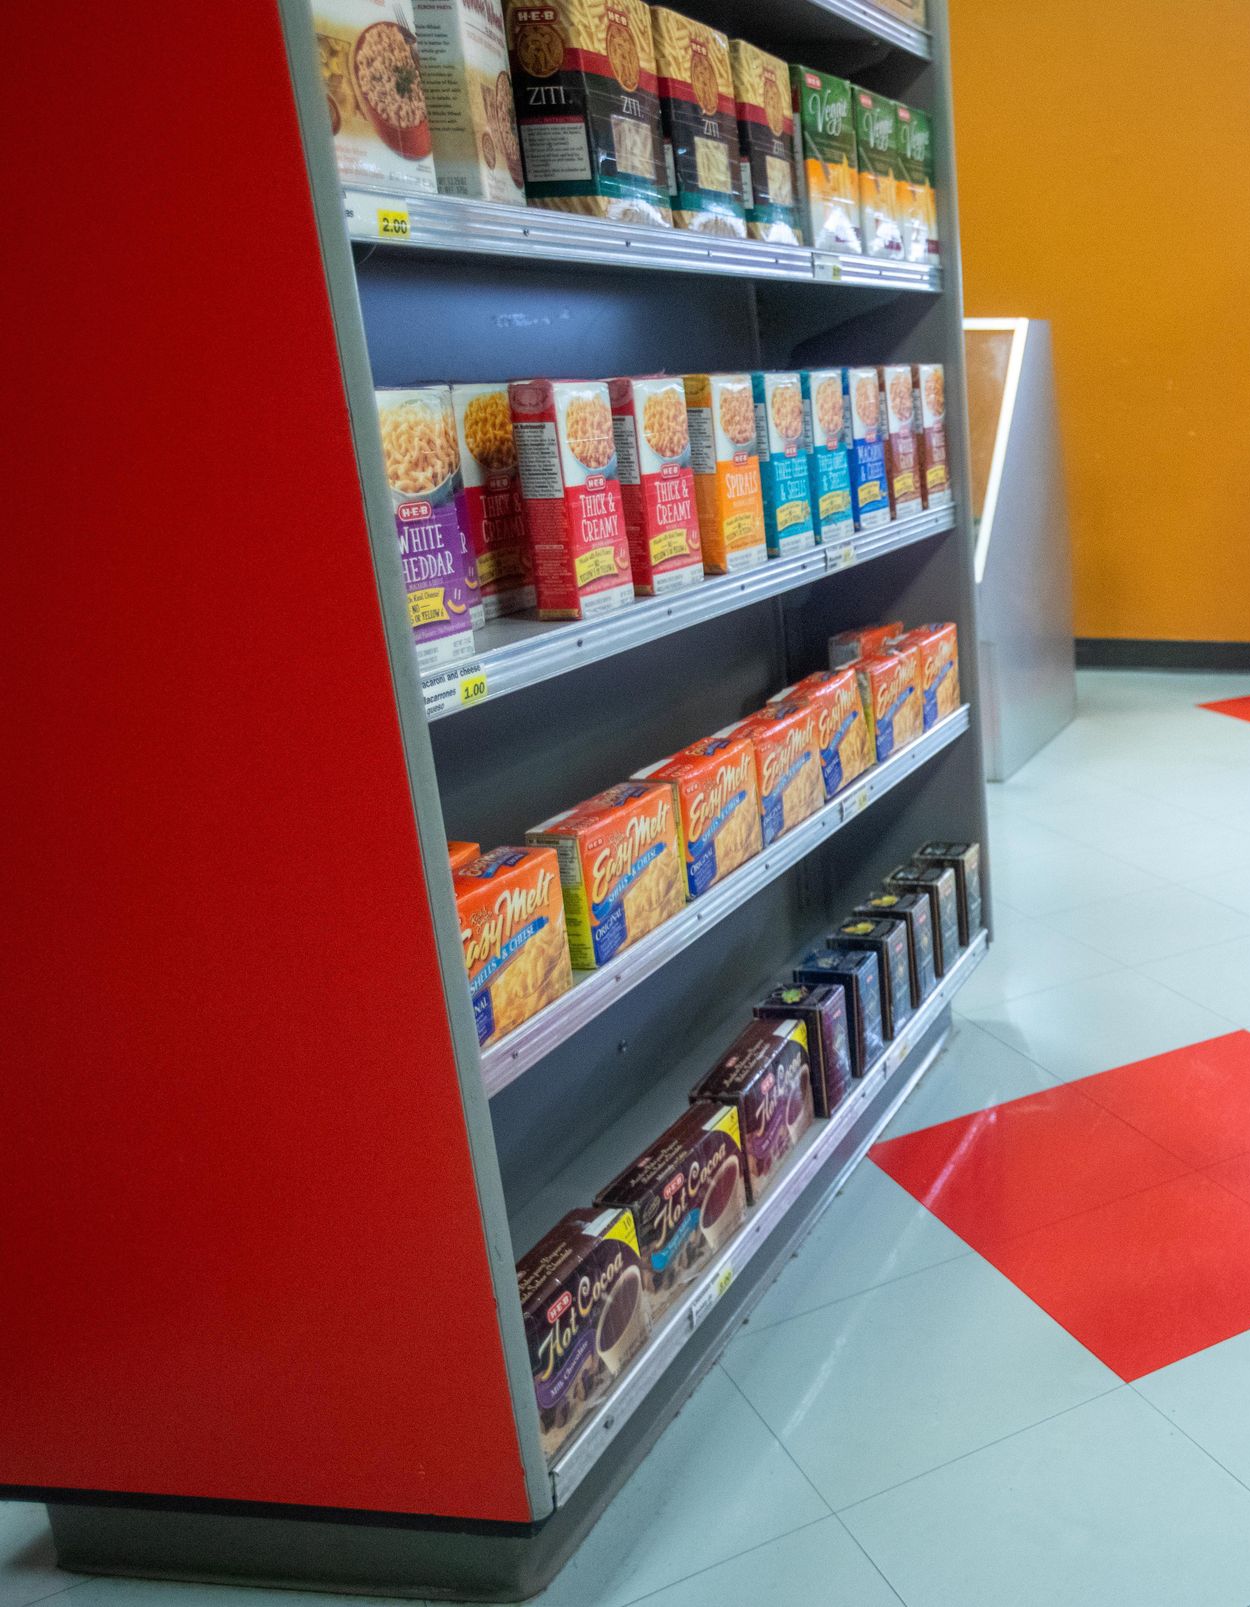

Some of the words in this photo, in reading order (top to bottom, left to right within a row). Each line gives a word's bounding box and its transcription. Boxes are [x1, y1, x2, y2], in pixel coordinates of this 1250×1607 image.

[382, 217, 408, 234] 2.00
[654, 480, 680, 503] THICK
[681, 478, 689, 498] &
[725, 470, 758, 499] SPIRALS
[579, 494, 607, 518] THICK
[608, 491, 615, 513] &
[656, 499, 692, 526] CREAMY
[400, 524, 445, 555] WHITE
[581, 515, 619, 543] CREAMY
[447, 670, 459, 682] and
[459, 664, 481, 678] cheese
[464, 681, 486, 700] 1.00
[689, 784, 722, 842] Easy
[716, 753, 751, 803] Melt
[592, 838, 632, 904] Easy
[626, 800, 670, 856] Melt
[494, 868, 555, 937] Melt
[595, 908, 622, 941] ORIGINAL
[470, 961, 497, 996] SHELLS
[509, 925, 535, 951] CHEESE
[653, 1187, 688, 1249] Hot
[688, 1143, 726, 1198] Cocoa
[538, 1306, 580, 1381] Hot
[578, 1251, 623, 1317] Cocoa
[550, 1380, 565, 1398] Milk
[563, 1340, 589, 1380] Chocolate
